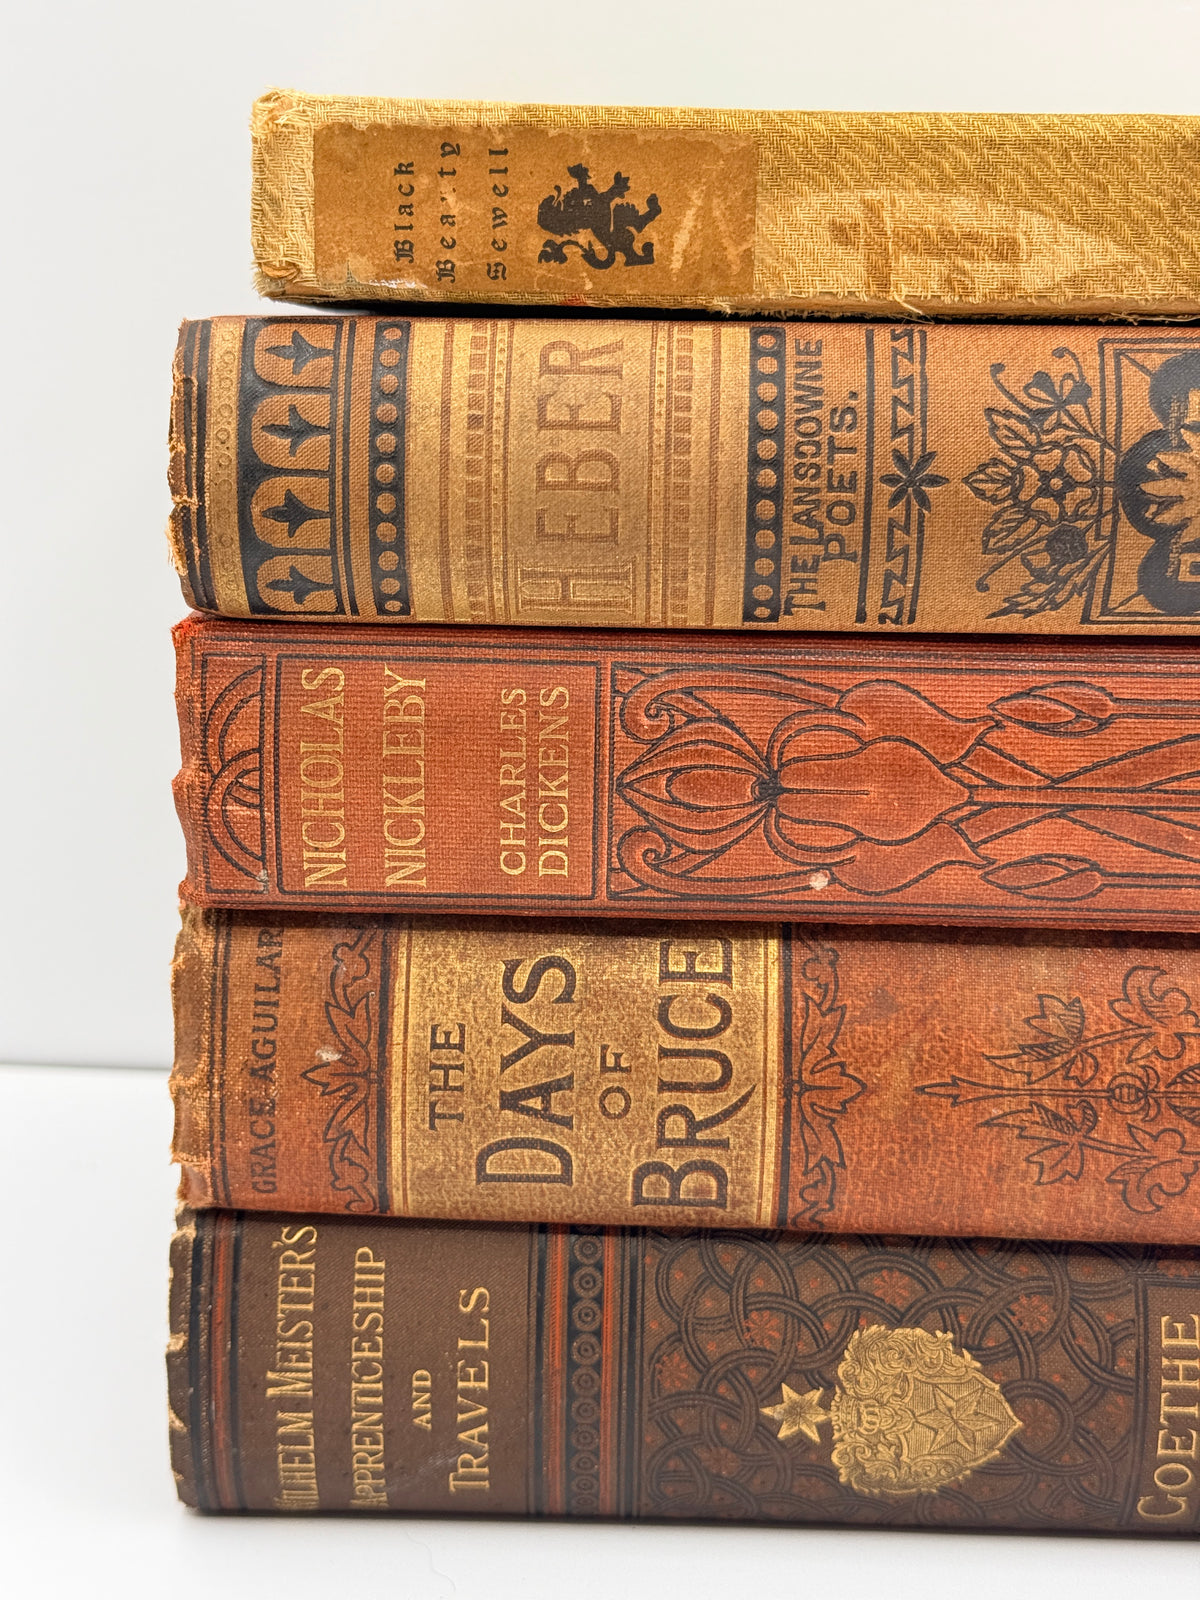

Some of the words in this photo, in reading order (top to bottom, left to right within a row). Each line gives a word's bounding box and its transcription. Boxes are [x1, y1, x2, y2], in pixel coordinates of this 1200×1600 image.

[394, 161, 414, 264] Black
[486, 147, 509, 281] Sewell
[517, 338, 636, 614] HEBER
[792, 338, 825, 547] LANSDOWNE
[822, 389, 858, 563] POETS.
[783, 550, 826, 617] THE
[301, 666, 347, 888] NICHOLAS
[383, 663, 427, 888] NICKLEBY
[500, 688, 527, 876] CHARLES
[539, 686, 569, 879] DICKENS
[250, 927, 284, 1082] AGUILAR
[428, 1022, 466, 1130] THE
[475, 956, 578, 1186] DAYS
[600, 1044, 632, 1120] OF
[631, 936, 757, 1210] BRUCE
[248, 1097, 277, 1194] GRACE
[266, 1225, 318, 1401] MEISTER'S
[350, 1246, 389, 1508] APPRENTICESHIP
[412, 1368, 432, 1431] AND
[449, 1287, 490, 1494] TRAVELS
[1137, 1314, 1200, 1521] GOETHE
